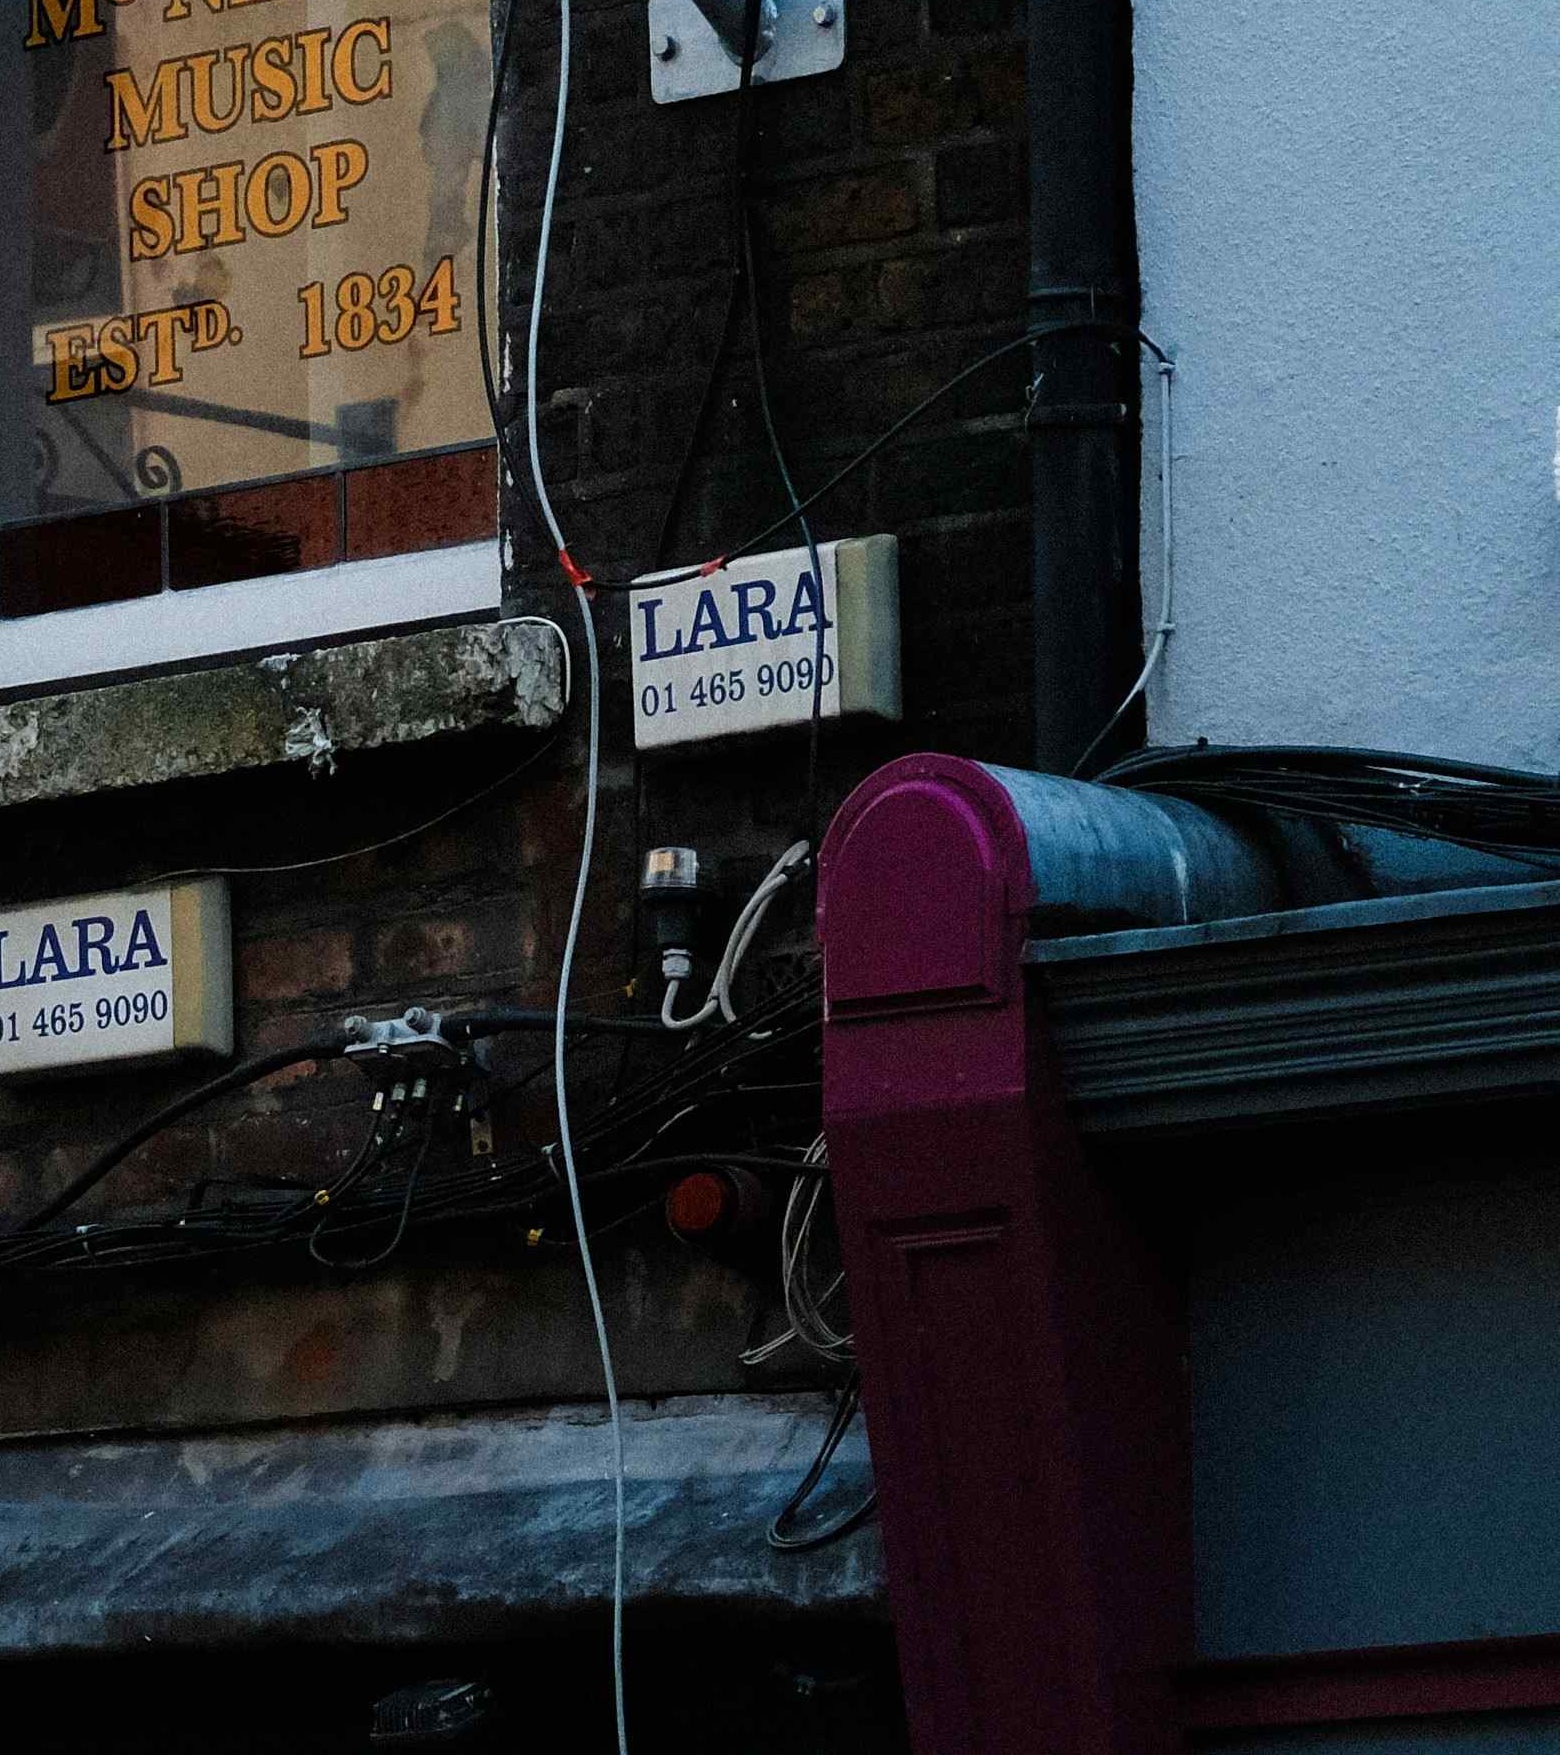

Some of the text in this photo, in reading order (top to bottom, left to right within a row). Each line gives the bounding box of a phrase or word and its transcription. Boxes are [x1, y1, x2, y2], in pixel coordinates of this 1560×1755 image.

[105, 16, 392, 153] MUSIC
[130, 139, 368, 262] SHOP
[298, 254, 462, 358] 1834
[638, 571, 833, 662] LARA
[642, 654, 834, 716] 01 465 9090
[33, 1002, 84, 1037] 465
[96, 990, 168, 1029] 9090
